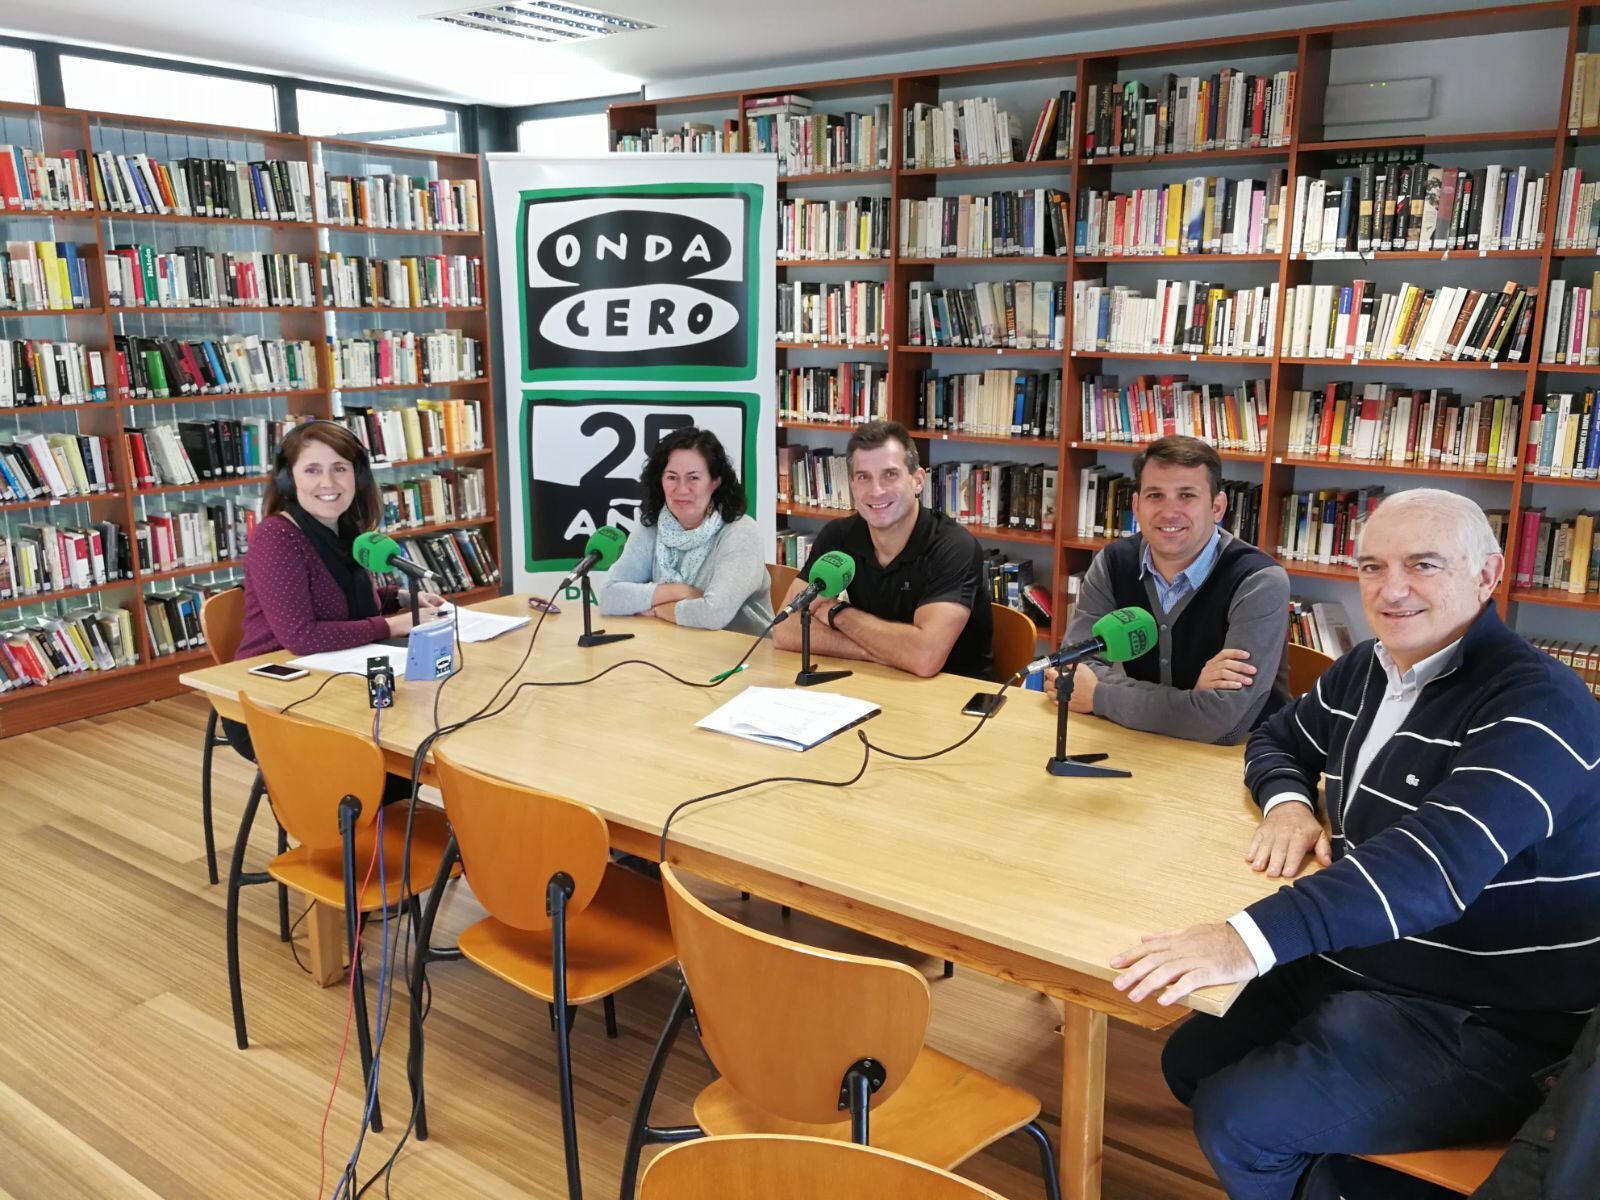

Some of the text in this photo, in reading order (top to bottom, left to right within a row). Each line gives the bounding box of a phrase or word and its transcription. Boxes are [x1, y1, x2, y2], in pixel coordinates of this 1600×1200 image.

[145, 248, 153, 277] Halcón
[555, 233, 711, 268] ONDA
[566, 298, 715, 337] CERO
[563, 498, 642, 541] AÑ
